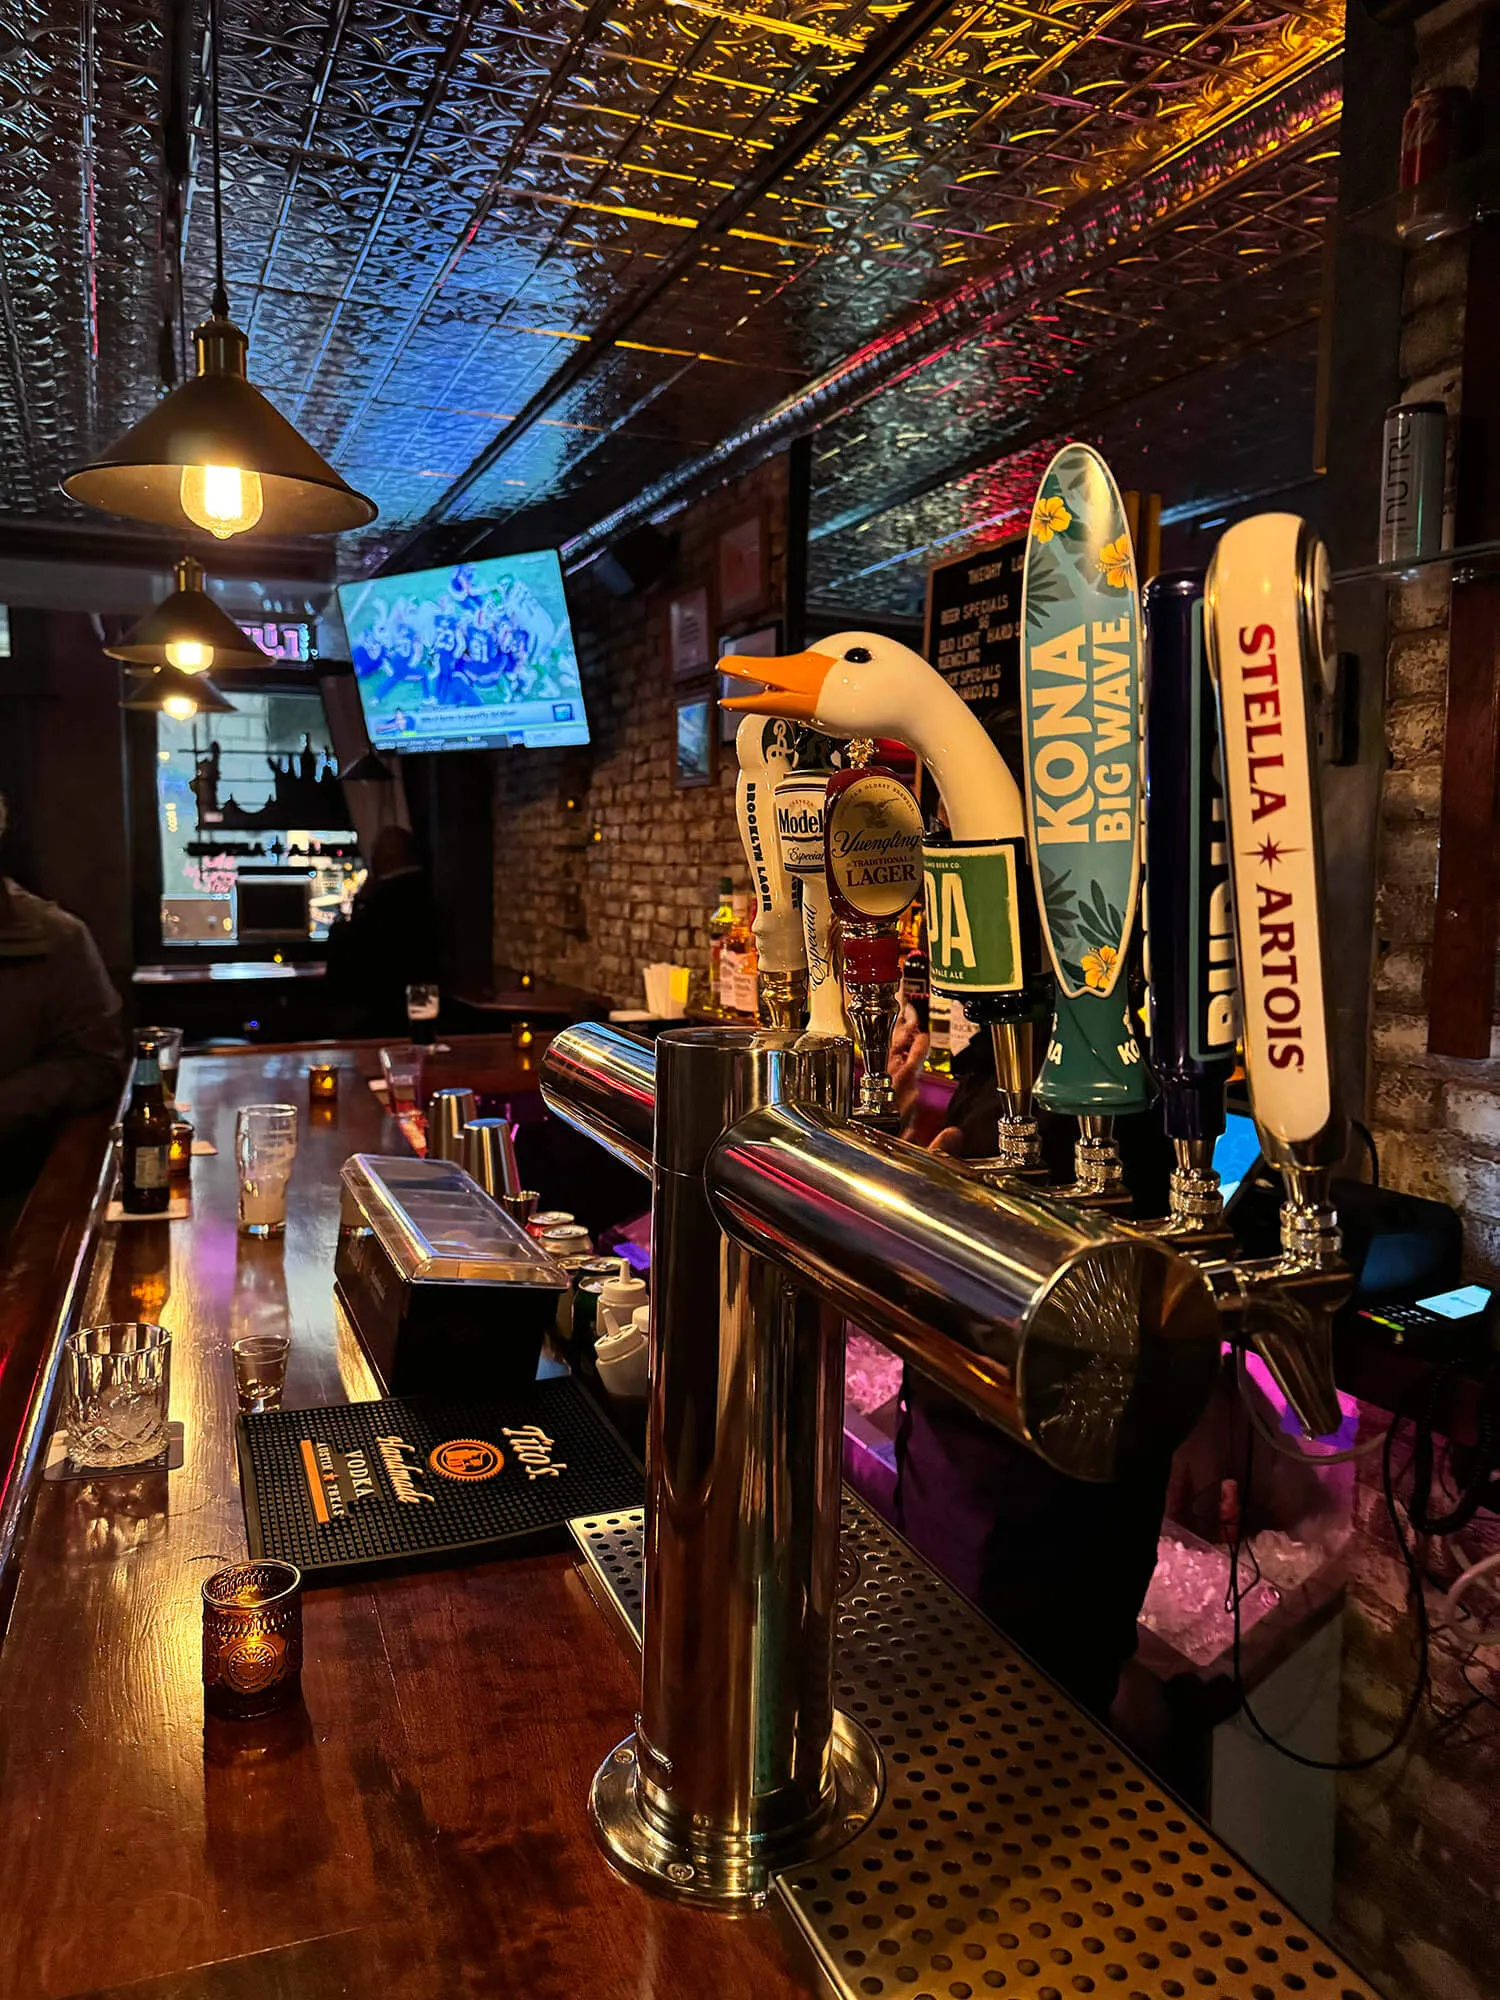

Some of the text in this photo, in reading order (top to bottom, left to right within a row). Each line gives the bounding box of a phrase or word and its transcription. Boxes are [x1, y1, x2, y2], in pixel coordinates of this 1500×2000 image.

[1030, 624, 1095, 845] KONA
[1092, 616, 1131, 843] BIG WAVE
[746, 783, 773, 912] BROOKLYN LAGER
[778, 808, 824, 834] Model
[832, 826, 925, 859] Yuengling
[1239, 624, 1305, 1070] STELLA ARTOIS
[846, 864, 917, 888] LAGER
[851, 856, 911, 868] TRADITIONAL
[805, 902, 829, 992] Especial
[923, 870, 976, 968] PA
[316, 1442, 346, 1516] AUSTIN TEXAS
[344, 1449, 375, 1499] VODKA
[375, 1435, 435, 1504] Handmade
[501, 1425, 567, 1480] Tito's
